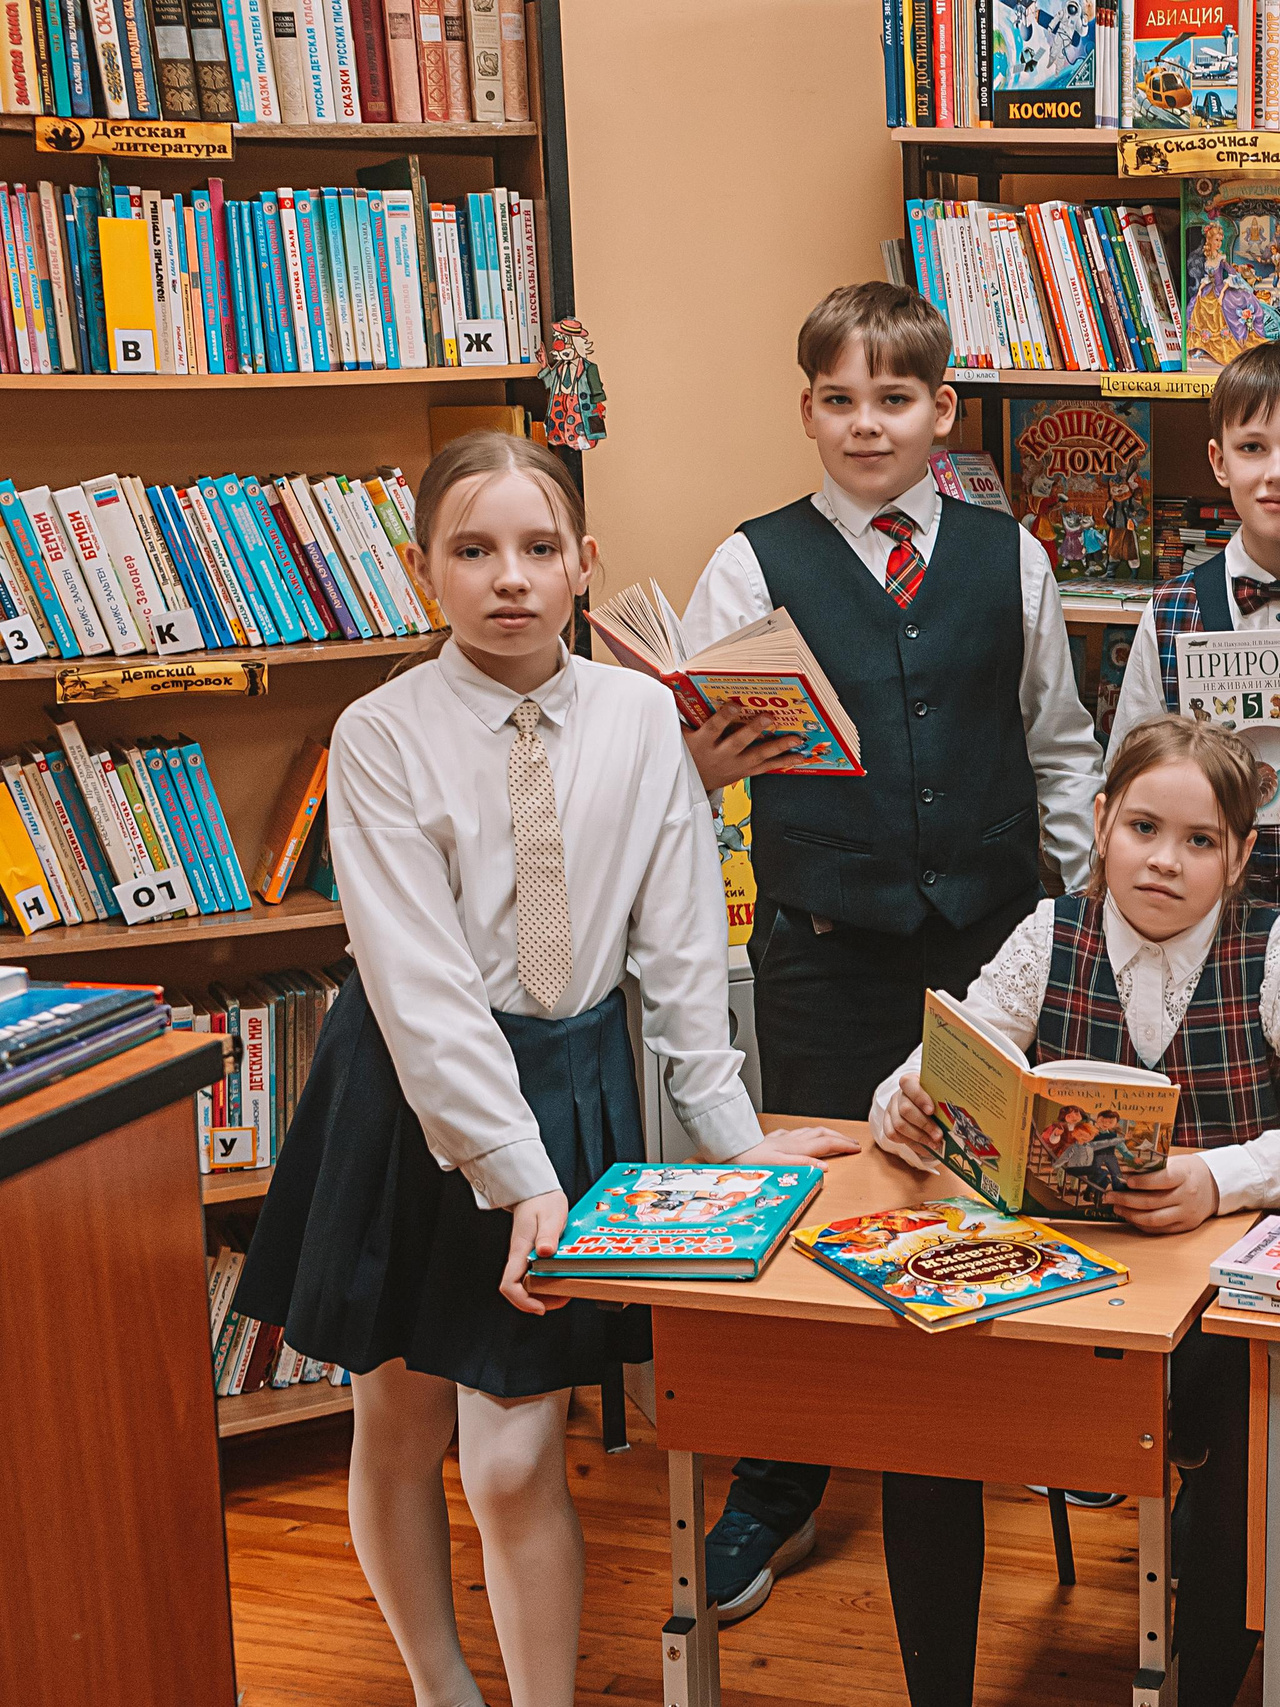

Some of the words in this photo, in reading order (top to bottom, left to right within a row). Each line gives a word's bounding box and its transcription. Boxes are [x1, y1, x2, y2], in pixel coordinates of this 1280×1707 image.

[5, 2, 22, 45] КНИГА
[884, 19, 892, 45] АТЛАС
[1145, 6, 1224, 28] АВИАЦИЯ
[1266, 12, 1279, 44] МИР
[70, 42, 80, 59] ПРО
[126, 20, 143, 69] НАРОДНЫЕ
[249, 15, 267, 73] ПИСАТЕЛЕЙ
[306, 27, 321, 71] ДЕТСКАЯ
[333, 25, 349, 65] РУССКИХ
[914, 2, 931, 88] ДОСТИЖЕНИЯ
[939, 53, 947, 68] мир
[10, 50, 30, 105] ЗОЛОТАЯ
[73, 62, 83, 94] СКАЗКИ
[133, 71, 150, 112] РУССКИЕ
[1266, 47, 1278, 107] ПОЗНАЮ
[258, 76, 272, 116] СКАЗКИ
[312, 74, 325, 118] РУССКАЯ
[340, 69, 354, 117] СКАЗКИ
[917, 93, 928, 116] ВСЕ
[939, 70, 947, 120] Удивительный
[1008, 101, 1082, 119] КОСМОС
[1265, 110, 1278, 122] Я
[92, 121, 187, 139] Детская
[1163, 135, 1259, 153] Сказочная
[112, 140, 229, 157] литература
[500, 202, 509, 243] ЖИВОТНЫХ
[522, 209, 532, 241] ДЕТЕЙ
[288, 229, 297, 258] ЗЕМЛИ
[525, 245, 534, 267] ДЛЯ
[154, 249, 166, 302] ЗОЛОТЫЕ
[503, 253, 513, 291] РАССКАЗЫ
[293, 270, 304, 312] ДЕВОЧКА
[527, 269, 538, 324] РАССКАЗЫ
[1069, 276, 1080, 306] ЧТЕНИЕ
[1163, 279, 1176, 307] ЧТЕНИЕ
[122, 340, 141, 361] В
[463, 333, 494, 352] Ж
[1078, 309, 1096, 364] ВНЕКЛАССНОЕ
[1100, 376, 1160, 393] Детская
[1019, 408, 1147, 464] КОШКИН
[1047, 447, 1118, 478] ДОМ
[969, 476, 994, 492] 100
[255, 499, 271, 526] ЧУДЕС
[33, 512, 64, 562] БЕМБИ
[67, 510, 98, 560] БЕМБИ
[269, 528, 287, 559] СТРАНЕ
[307, 543, 328, 578] КЭРРОЛЛ
[62, 568, 83, 603] ЗАЛЬТЕН
[95, 567, 116, 602] ЗАЛЬТЕН
[122, 555, 147, 605] Заходер
[287, 568, 304, 596] АЛИСА
[76, 605, 96, 638] ФЕЛИКС
[109, 604, 128, 636] ФЕЛИКС
[156, 622, 179, 645] К
[121, 665, 196, 683] Детский
[151, 677, 233, 691] островок
[1203, 680, 1255, 691] НЕЖИВАЯ
[728, 695, 789, 708] 100
[1247, 693, 1259, 718] 5
[63, 827, 87, 871] МИШКИНА
[23, 896, 46, 919] Н
[132, 886, 156, 907] О
[248, 1017, 263, 1040] МИР
[247, 1043, 264, 1091] ДЕТСКИЙ
[1109, 1101, 1165, 1113] Машуня
[219, 1138, 237, 1157] У
[556, 1245, 737, 1255] РУССКИЕ
[574, 1235, 734, 1246] СКАЗКИ
[917, 1243, 1014, 1269] Сказки
[933, 1251, 1024, 1276] волшебные
[954, 1259, 1024, 1279] Русские
